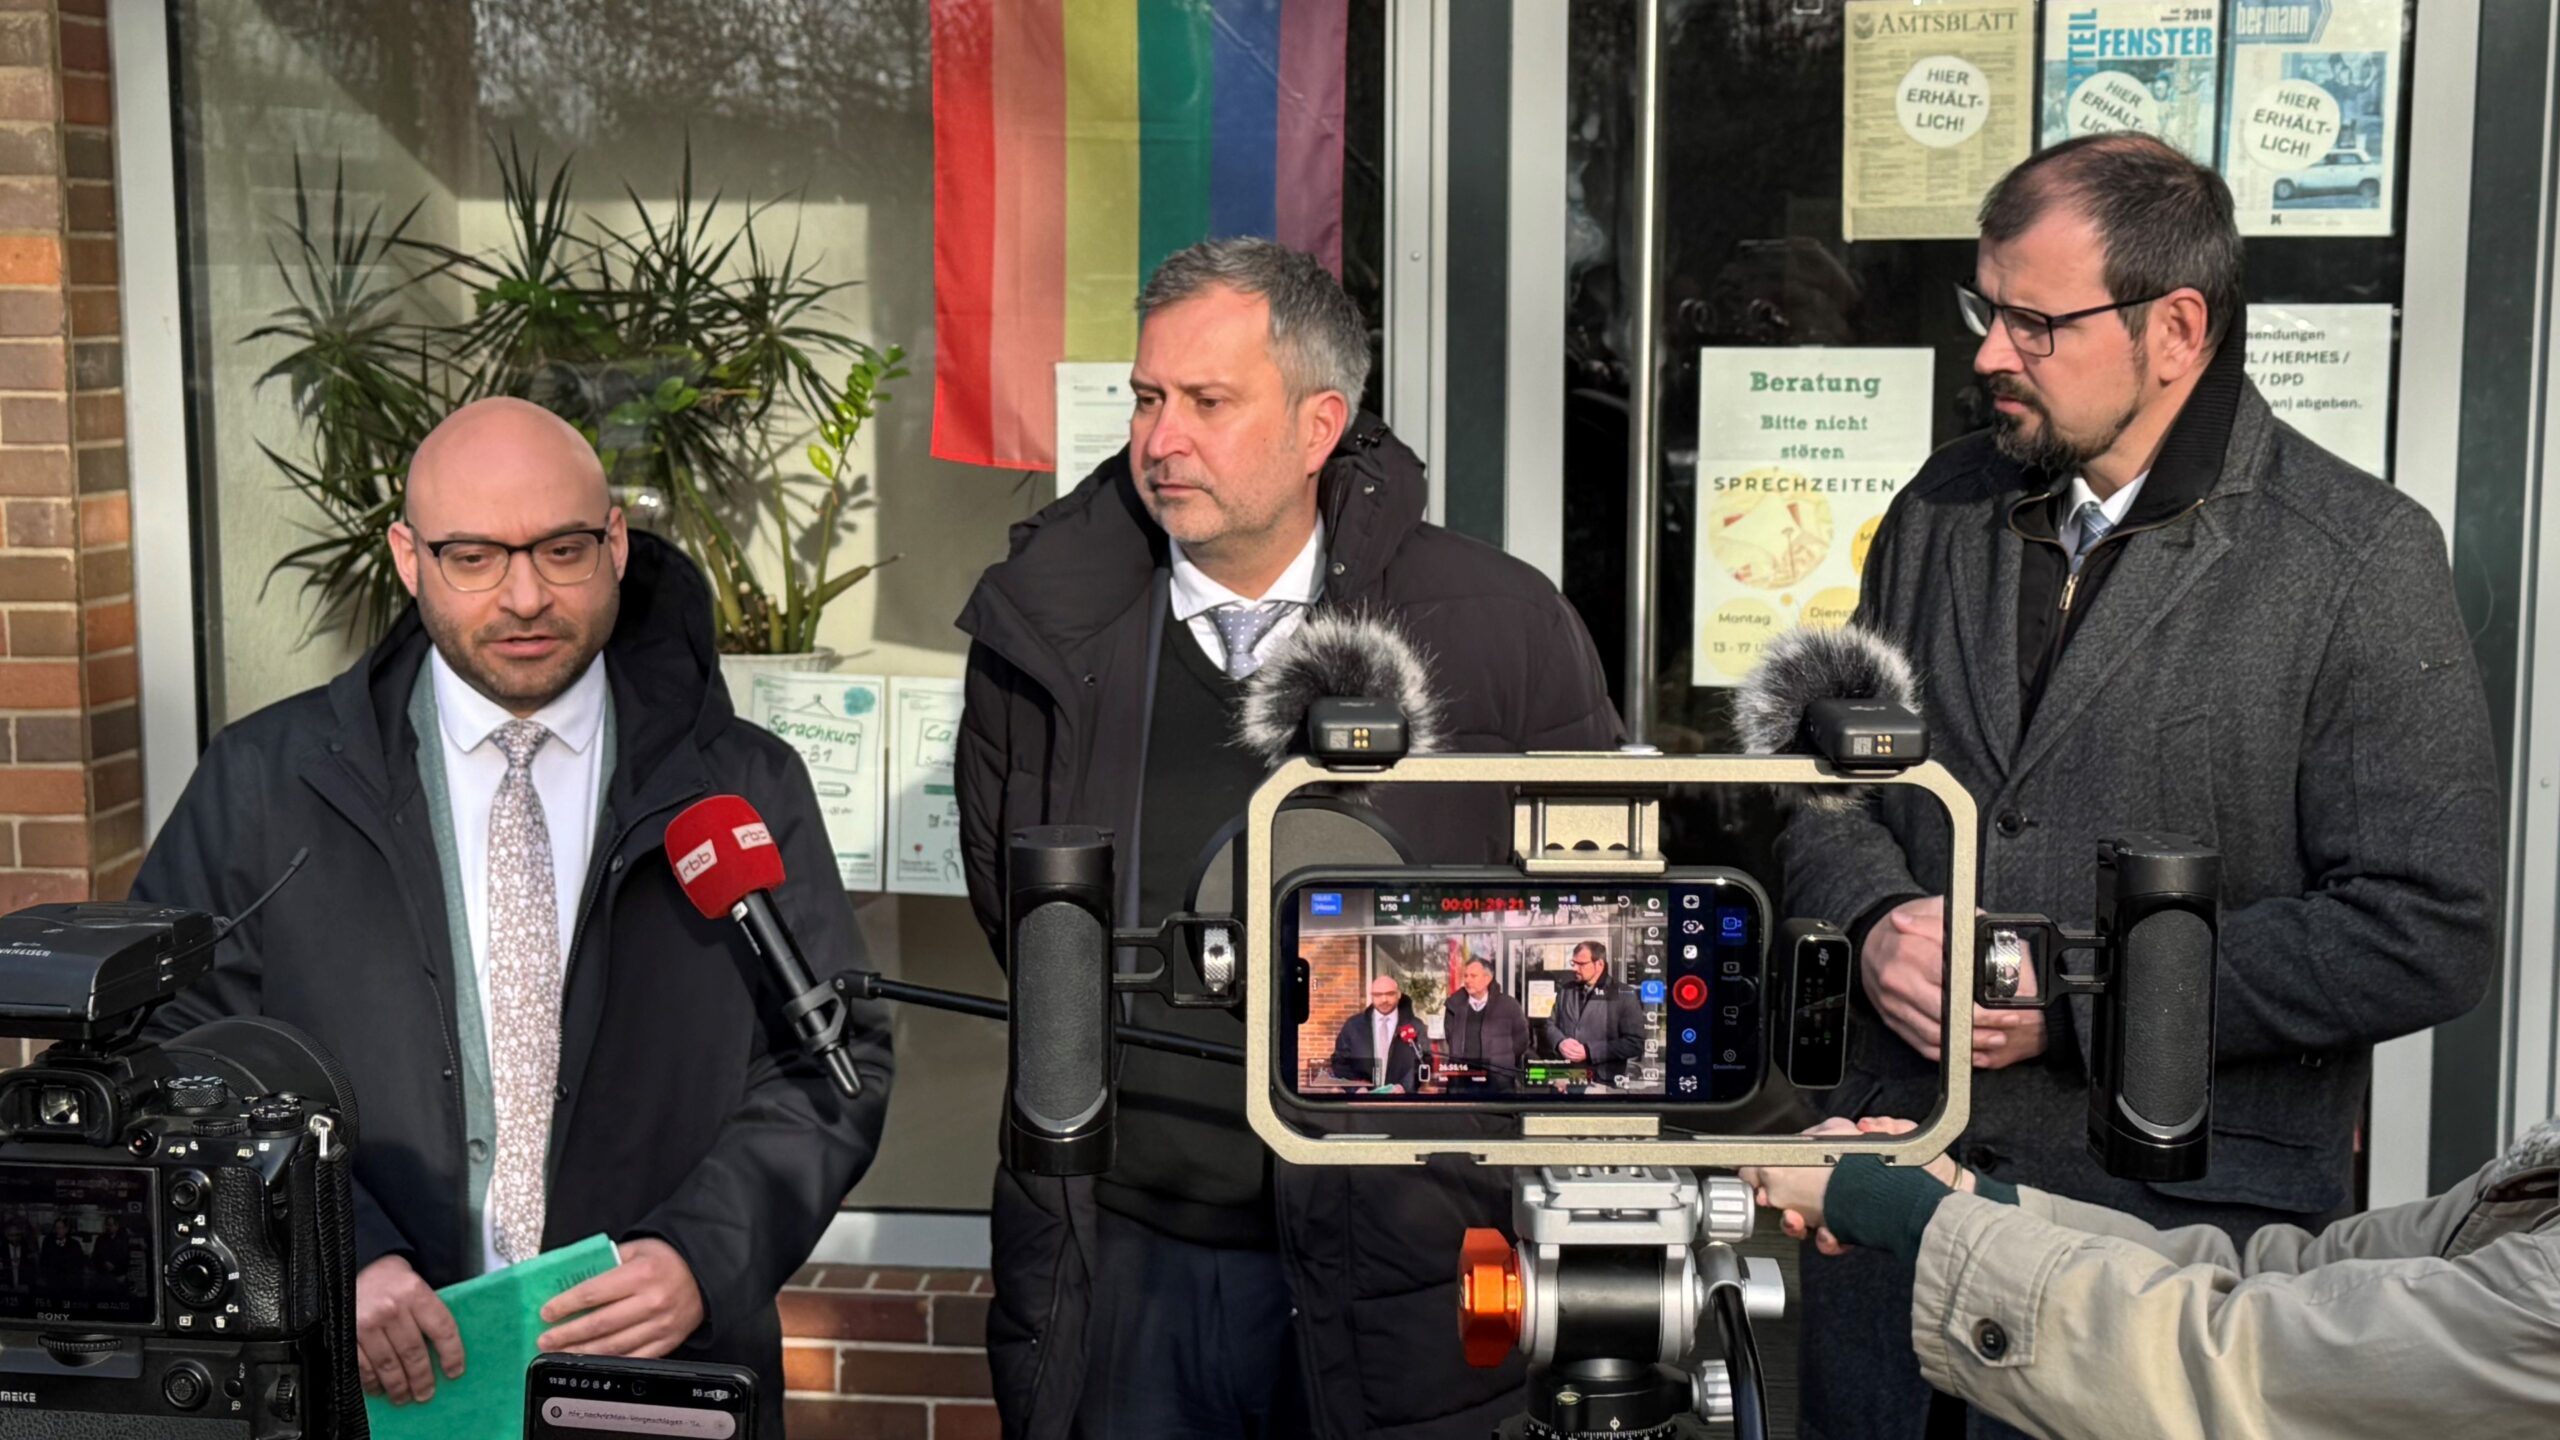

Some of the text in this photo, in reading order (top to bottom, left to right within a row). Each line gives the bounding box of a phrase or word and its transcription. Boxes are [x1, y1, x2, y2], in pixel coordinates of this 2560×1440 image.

[1878, 13, 2016, 34] AMTSBLATT
[2098, 26, 2214, 57] FENSTER
[1927, 68, 1970, 85] HIER
[2104, 80, 2143, 108] HIER
[2277, 90, 2320, 111] HIER
[1916, 112, 1965, 132] LICH!
[2079, 114, 2113, 134] LIC
[2260, 133, 2311, 158] LICH!
[2272, 351, 2340, 365] HERMES
[1750, 371, 1882, 399] Beratung
[2269, 373, 2304, 386] DPD
[2295, 397, 2364, 411] abgeben.
[1760, 414, 1868, 431] Bitte nicht
[1780, 443, 1845, 460] stören
[1713, 477, 1896, 493] SPRECHZEITEN
[1718, 613, 1771, 626] Montag
[769, 714, 862, 745] Sprachkurs
[924, 725, 953, 742] Ca
[682, 851, 712, 877] rbb
[37, 1312, 70, 1321] SONY
[226, 1303, 239, 1313] C4
